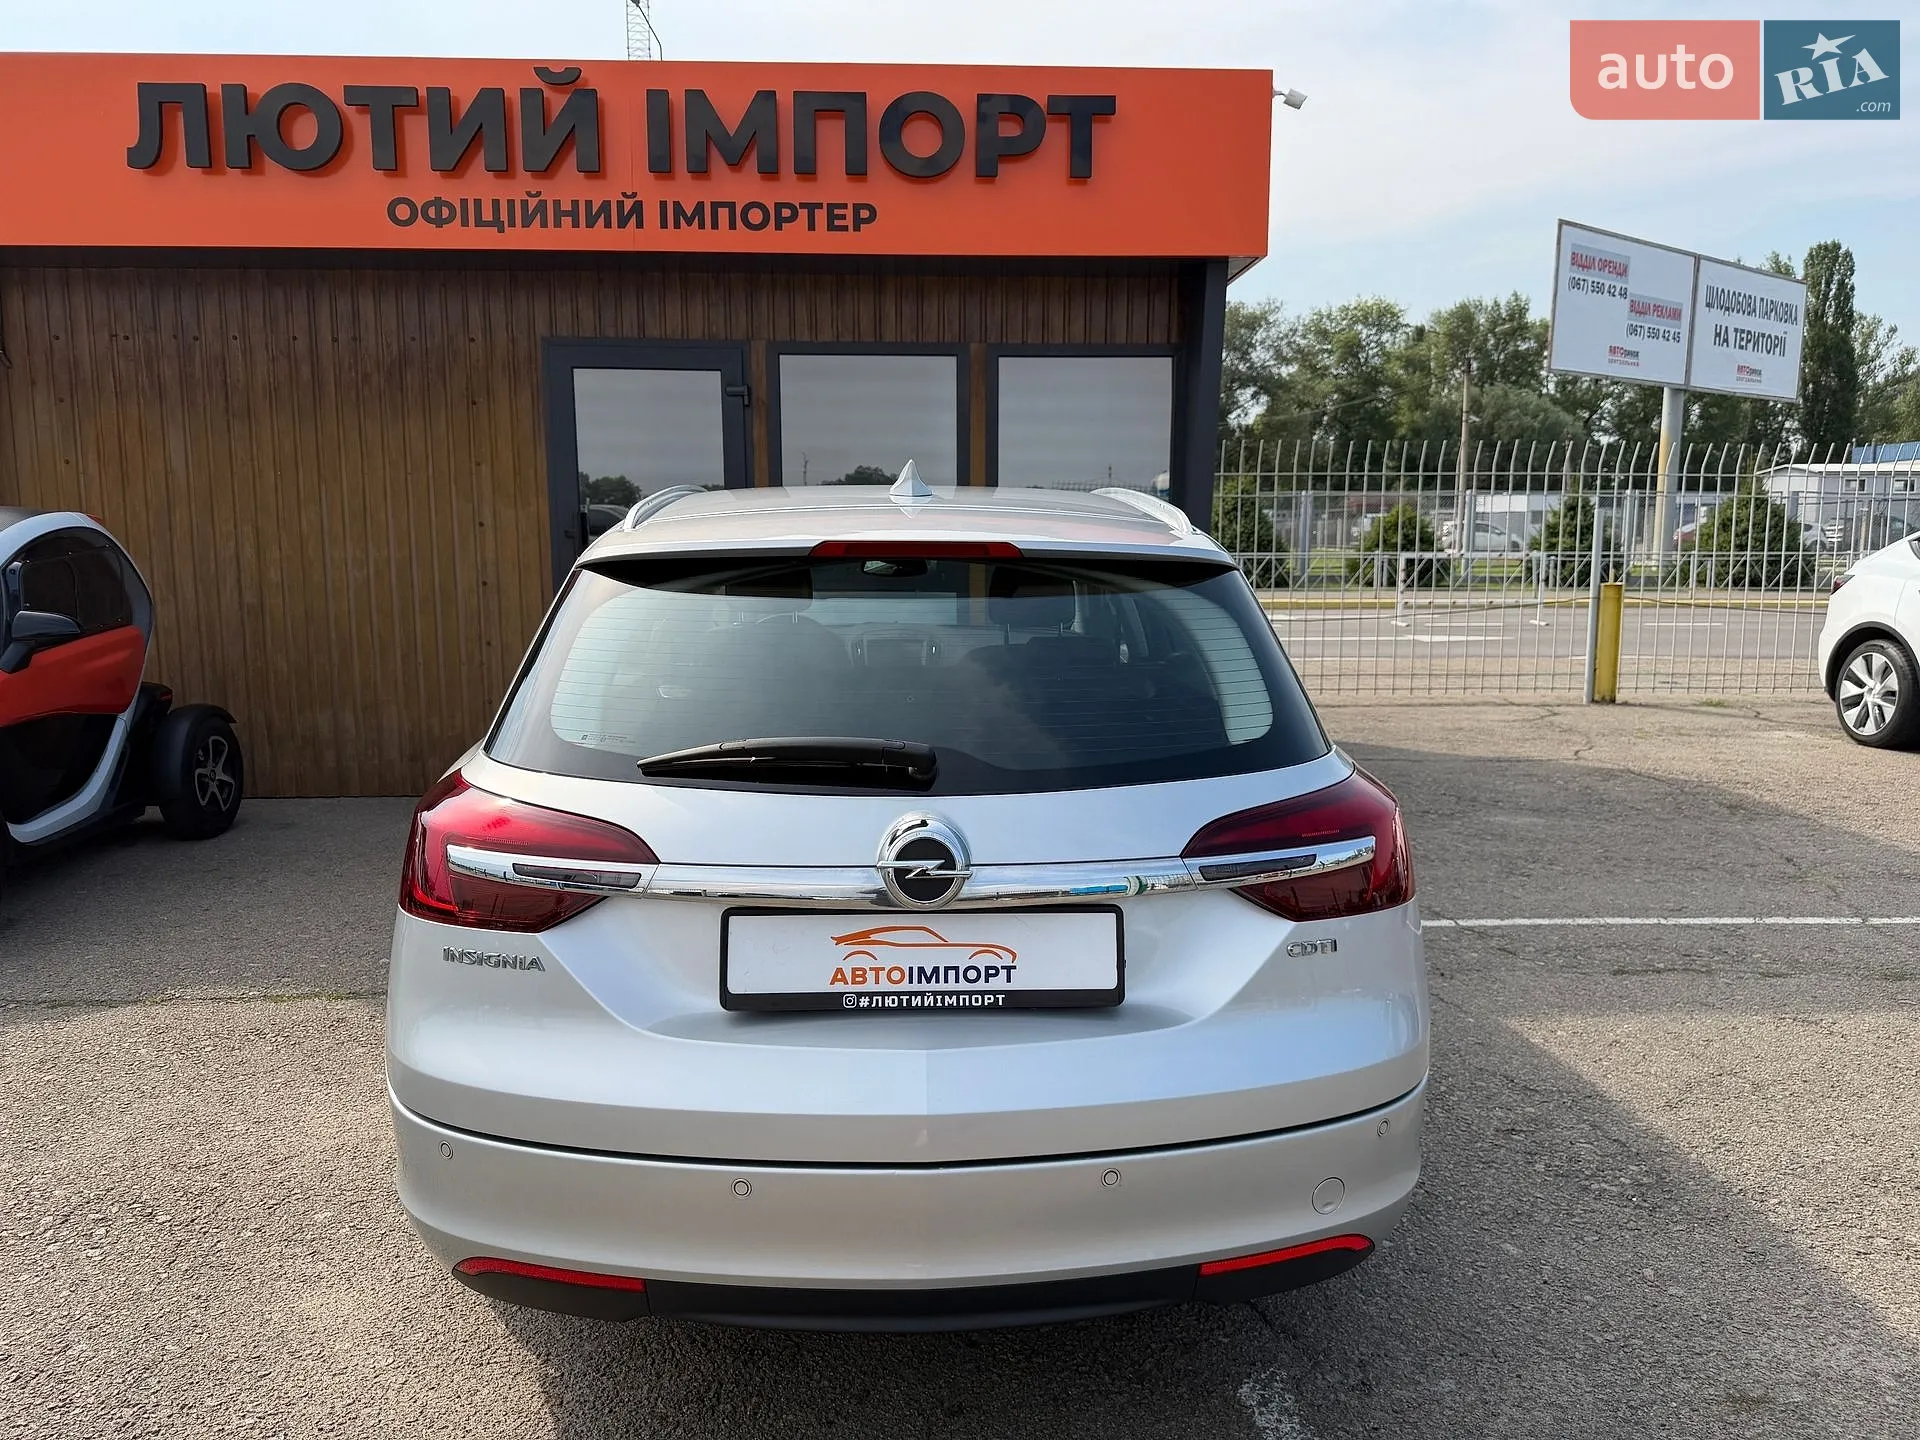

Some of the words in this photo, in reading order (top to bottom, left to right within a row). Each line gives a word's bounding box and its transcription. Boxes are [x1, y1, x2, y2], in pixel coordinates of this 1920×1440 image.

[126, 66, 601, 174] ЛЮТИЙ
[645, 88, 1117, 180] ІМПОРТ
[386, 190, 645, 234] ОФІЦІЙНИЙ
[659, 199, 878, 233] ІМПОРТЕР
[1570, 251, 1596, 272] ВІДДІЛ
[1597, 257, 1628, 278] ОРЕНДИ
[1567, 275, 1589, 294] (067)
[1590, 280, 1605, 295] 550
[1606, 283, 1617, 297] 42
[1618, 286, 1628, 300] 48
[1629, 299, 1651, 318] ВІДДІЛ
[1652, 303, 1682, 322] РЕКЛАМИ
[1705, 284, 1757, 318] ЦІЛОДОБОВА
[1758, 296, 1798, 326] ПАРКОВКА
[1625, 322, 1646, 341] (067)
[1646, 326, 1660, 341] 550
[1661, 328, 1671, 342] 42
[1671, 330, 1681, 343] 45
[1713, 323, 1730, 348] НА
[1733, 327, 1788, 357] ТЕРИТОРІЇ
[442, 945, 546, 972] INSIGNIA
[829, 964, 1017, 986] АВТОІМПОРТ
[859, 992, 1006, 1008] #ЛЮТИЙІМПОРТ
